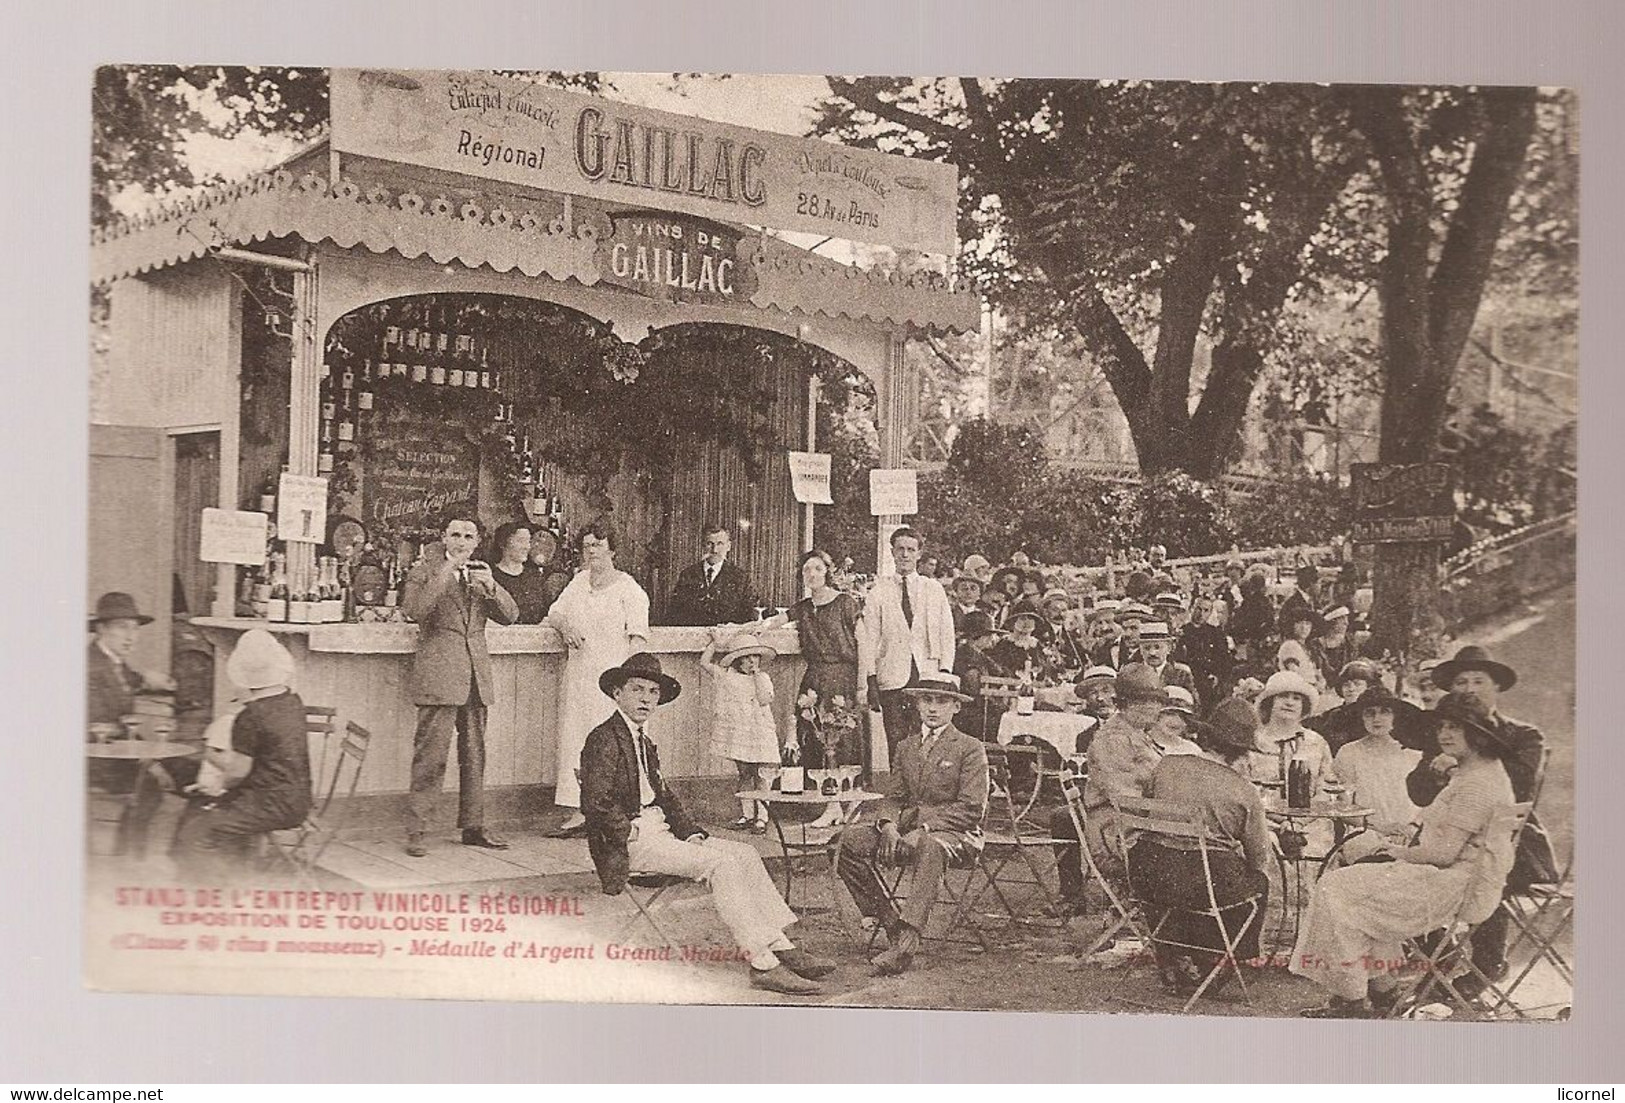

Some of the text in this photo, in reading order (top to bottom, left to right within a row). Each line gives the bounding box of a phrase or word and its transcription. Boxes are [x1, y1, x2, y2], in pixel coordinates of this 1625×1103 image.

[457, 130, 546, 170] Régional
[573, 106, 766, 207] GAILLAC
[847, 201, 878, 229] Paris
[632, 222, 722, 251] VINS DE
[612, 242, 734, 296] GAILLAC
